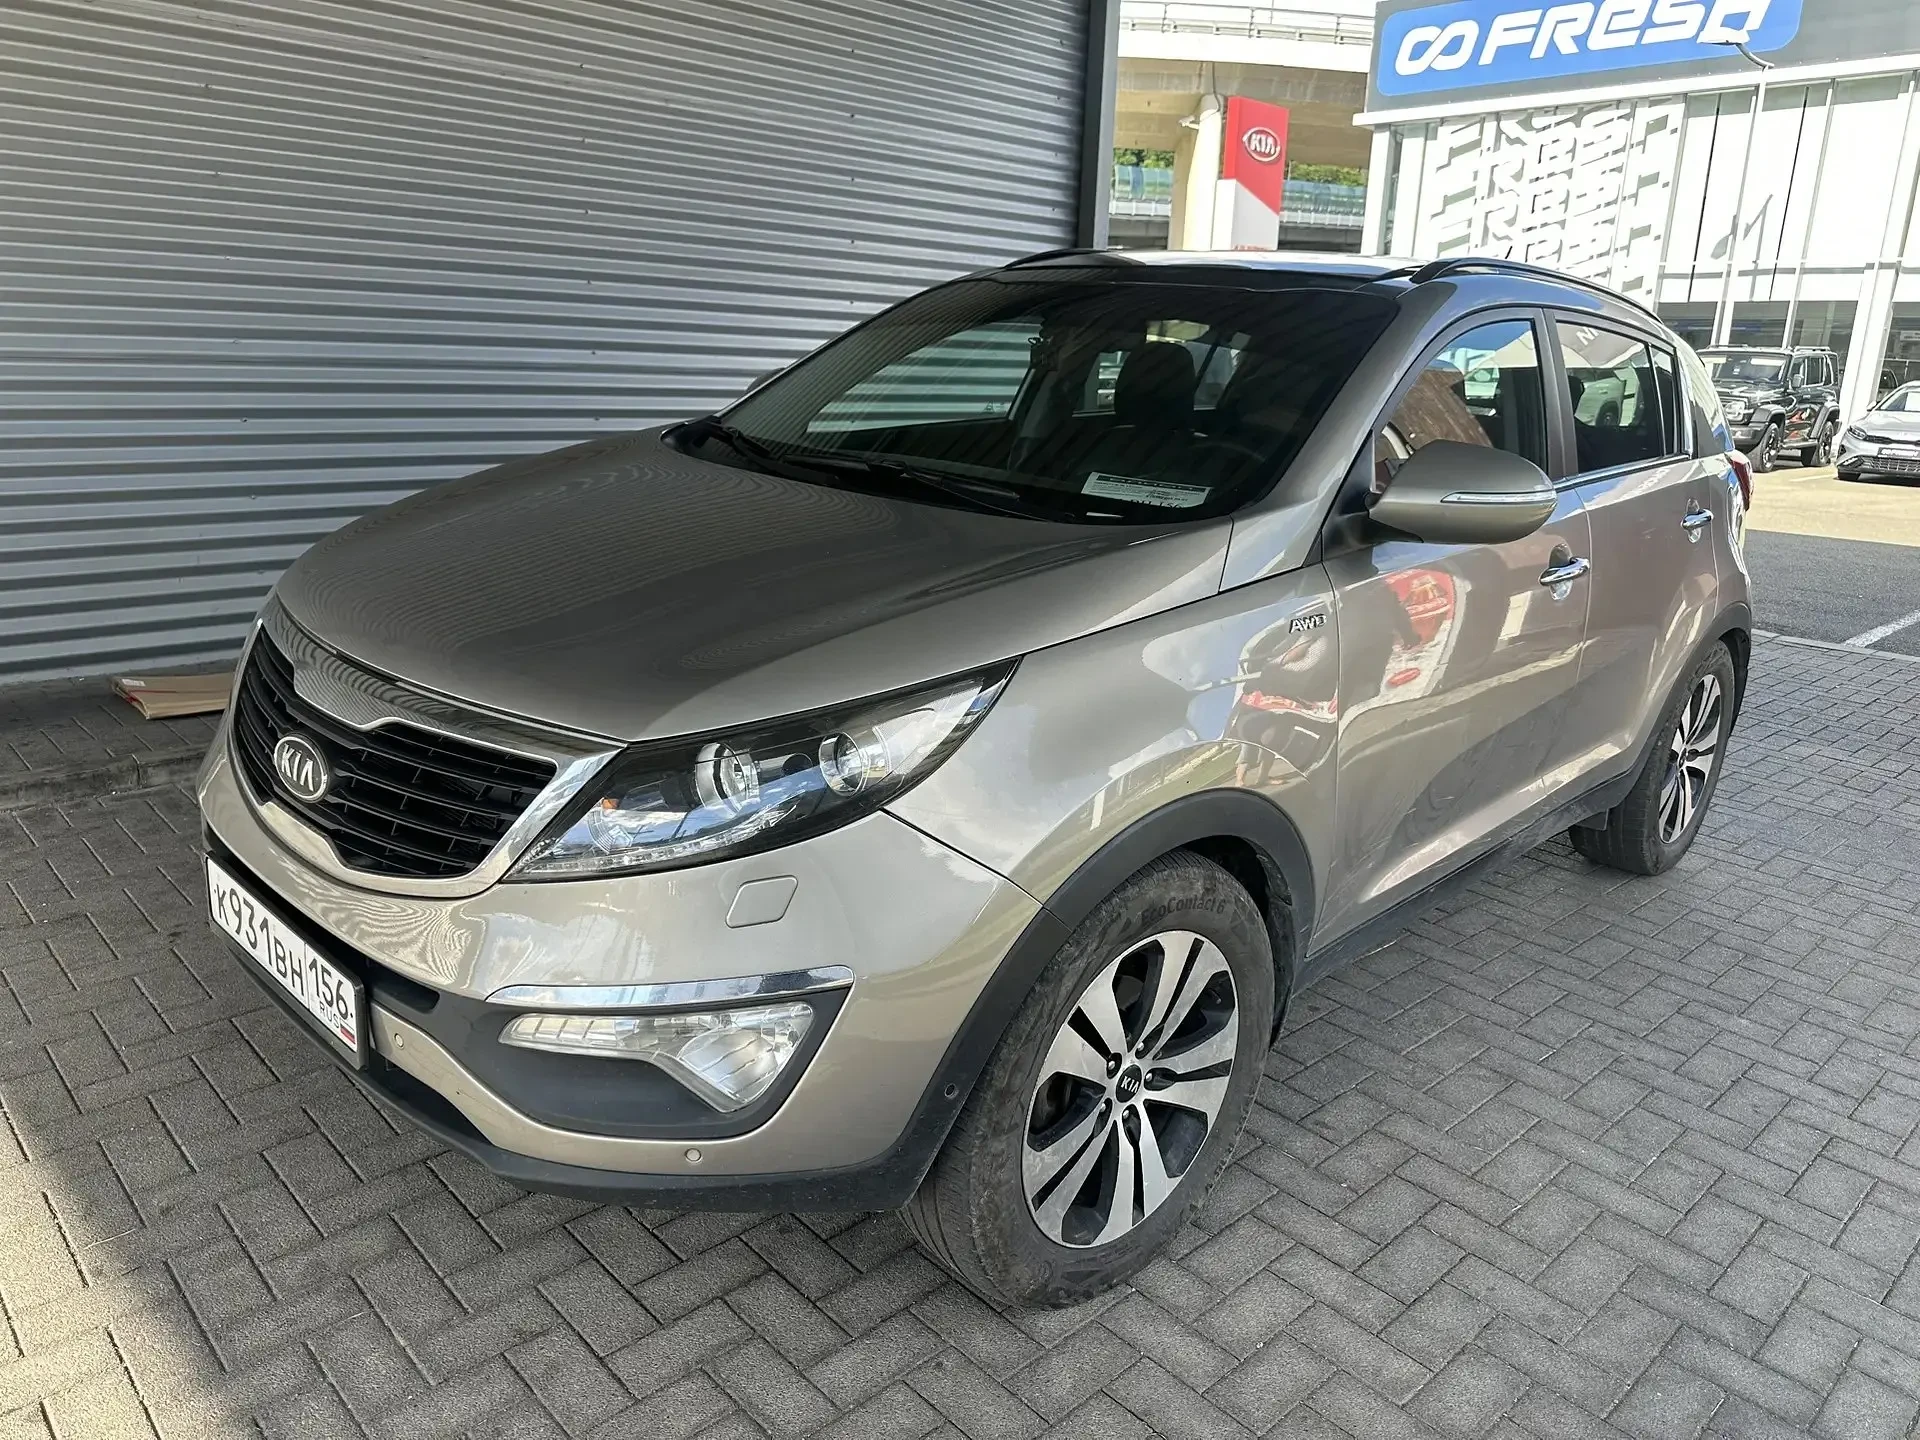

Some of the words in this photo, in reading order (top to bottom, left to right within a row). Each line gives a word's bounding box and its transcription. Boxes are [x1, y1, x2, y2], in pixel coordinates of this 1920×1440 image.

[1250, 132, 1276, 155] KIA
[1289, 613, 1327, 633] AWD
[281, 743, 314, 792] KIA
[308, 957, 349, 1020] 156
[319, 1001, 340, 1029] RUS
[1120, 1075, 1140, 1093] KIA
